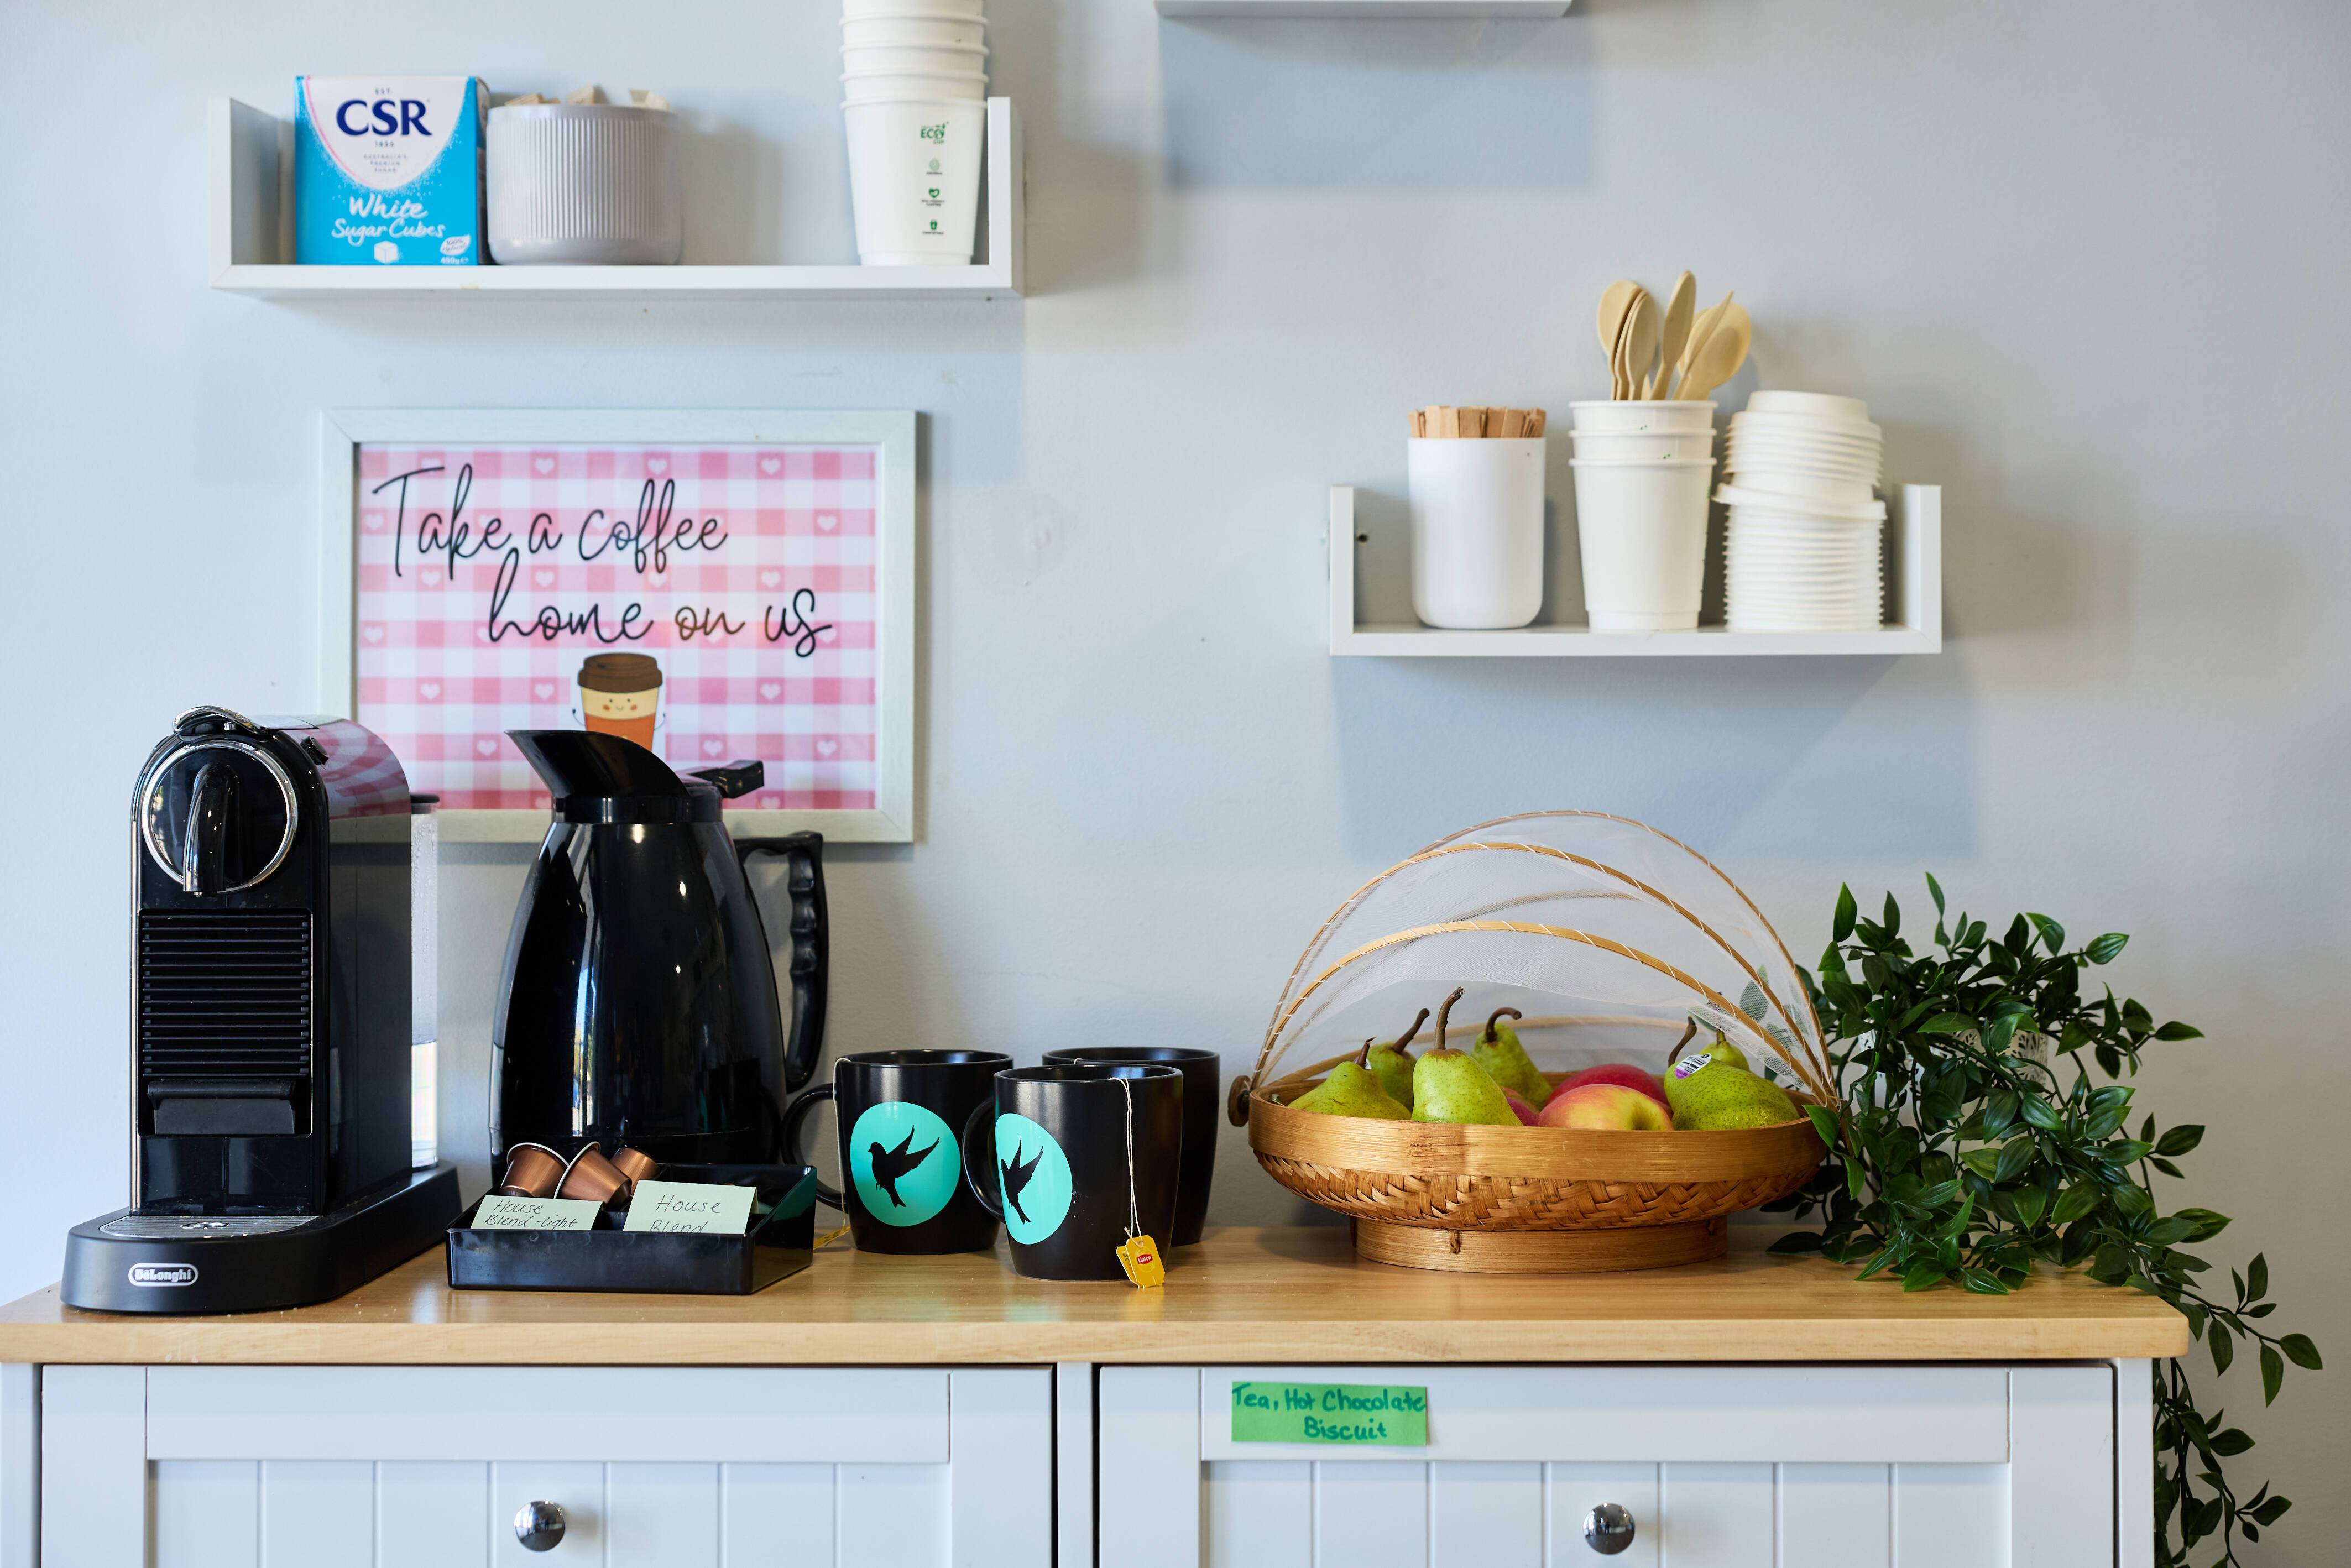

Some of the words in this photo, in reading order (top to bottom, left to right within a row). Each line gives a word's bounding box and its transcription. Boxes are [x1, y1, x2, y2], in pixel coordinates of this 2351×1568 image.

[336, 99, 432, 136] CSR
[921, 128, 944, 139] ECO
[349, 193, 429, 219] White
[332, 218, 387, 247] Sugar
[389, 217, 446, 238] Cubes
[372, 463, 512, 580] Take
[527, 512, 563, 554] a
[579, 479, 728, 574] coffee
[489, 547, 654, 643] home
[674, 605, 745, 642] on
[764, 587, 833, 657] us
[493, 1200, 544, 1214] House
[656, 1194, 720, 1213] House
[485, 1214, 534, 1228] Blend
[650, 1219, 708, 1233] Blend
[1232, 1383, 1279, 1410] Tea,
[1284, 1388, 1315, 1411] Hot
[1322, 1388, 1427, 1412] Chocolate
[1304, 1415, 1387, 1440] Biscuit
